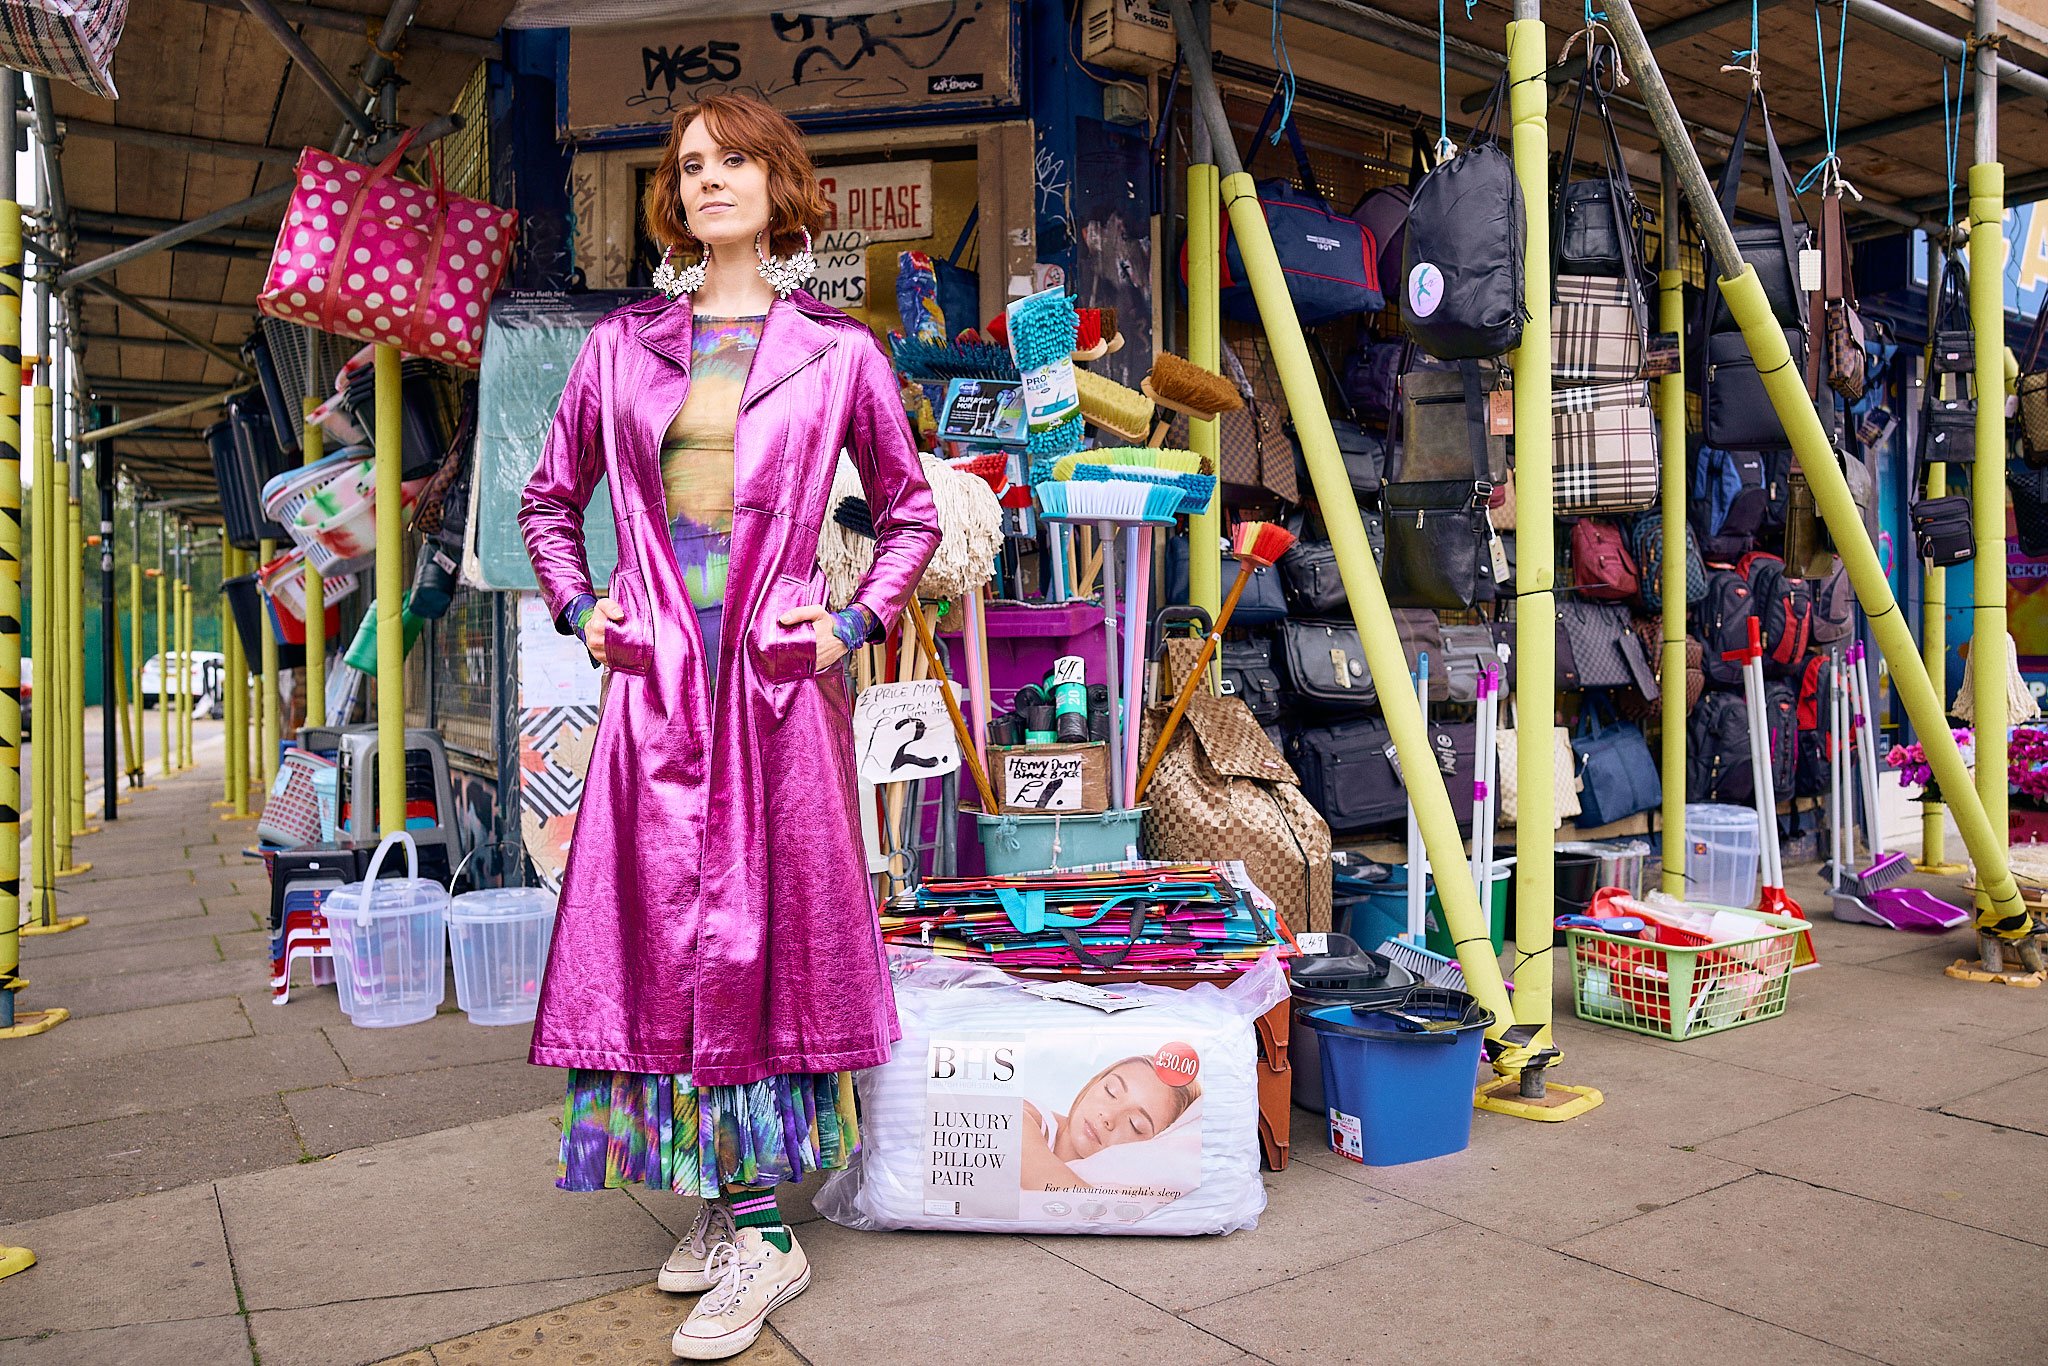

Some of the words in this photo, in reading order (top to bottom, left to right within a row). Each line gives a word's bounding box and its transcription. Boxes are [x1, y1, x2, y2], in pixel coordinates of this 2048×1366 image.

[848, 185, 922, 231] PLEASE
[824, 231, 861, 254] NO
[828, 254, 860, 269] NO
[800, 276, 867, 301] RAMS
[1026, 374, 1047, 386] PRO
[1027, 382, 1048, 391] KLEEN
[874, 685, 908, 702] PRICE
[865, 703, 927, 721] COTTON
[1008, 758, 1049, 772] HEAVY
[1050, 758, 1082, 772] DUTY
[931, 1046, 1015, 1082] BHS
[1156, 1050, 1197, 1076] £30.00
[933, 1111, 1013, 1130] LUXURY
[932, 1130, 998, 1149] HOTEL
[932, 1151, 1006, 1169] PILLOW
[931, 1170, 975, 1187] PAIR
[1044, 1183, 1061, 1193] For
[1072, 1184, 1119, 1196] luxurious
[1120, 1186, 1155, 1198] night's
[1156, 1187, 1182, 1200] sleep
